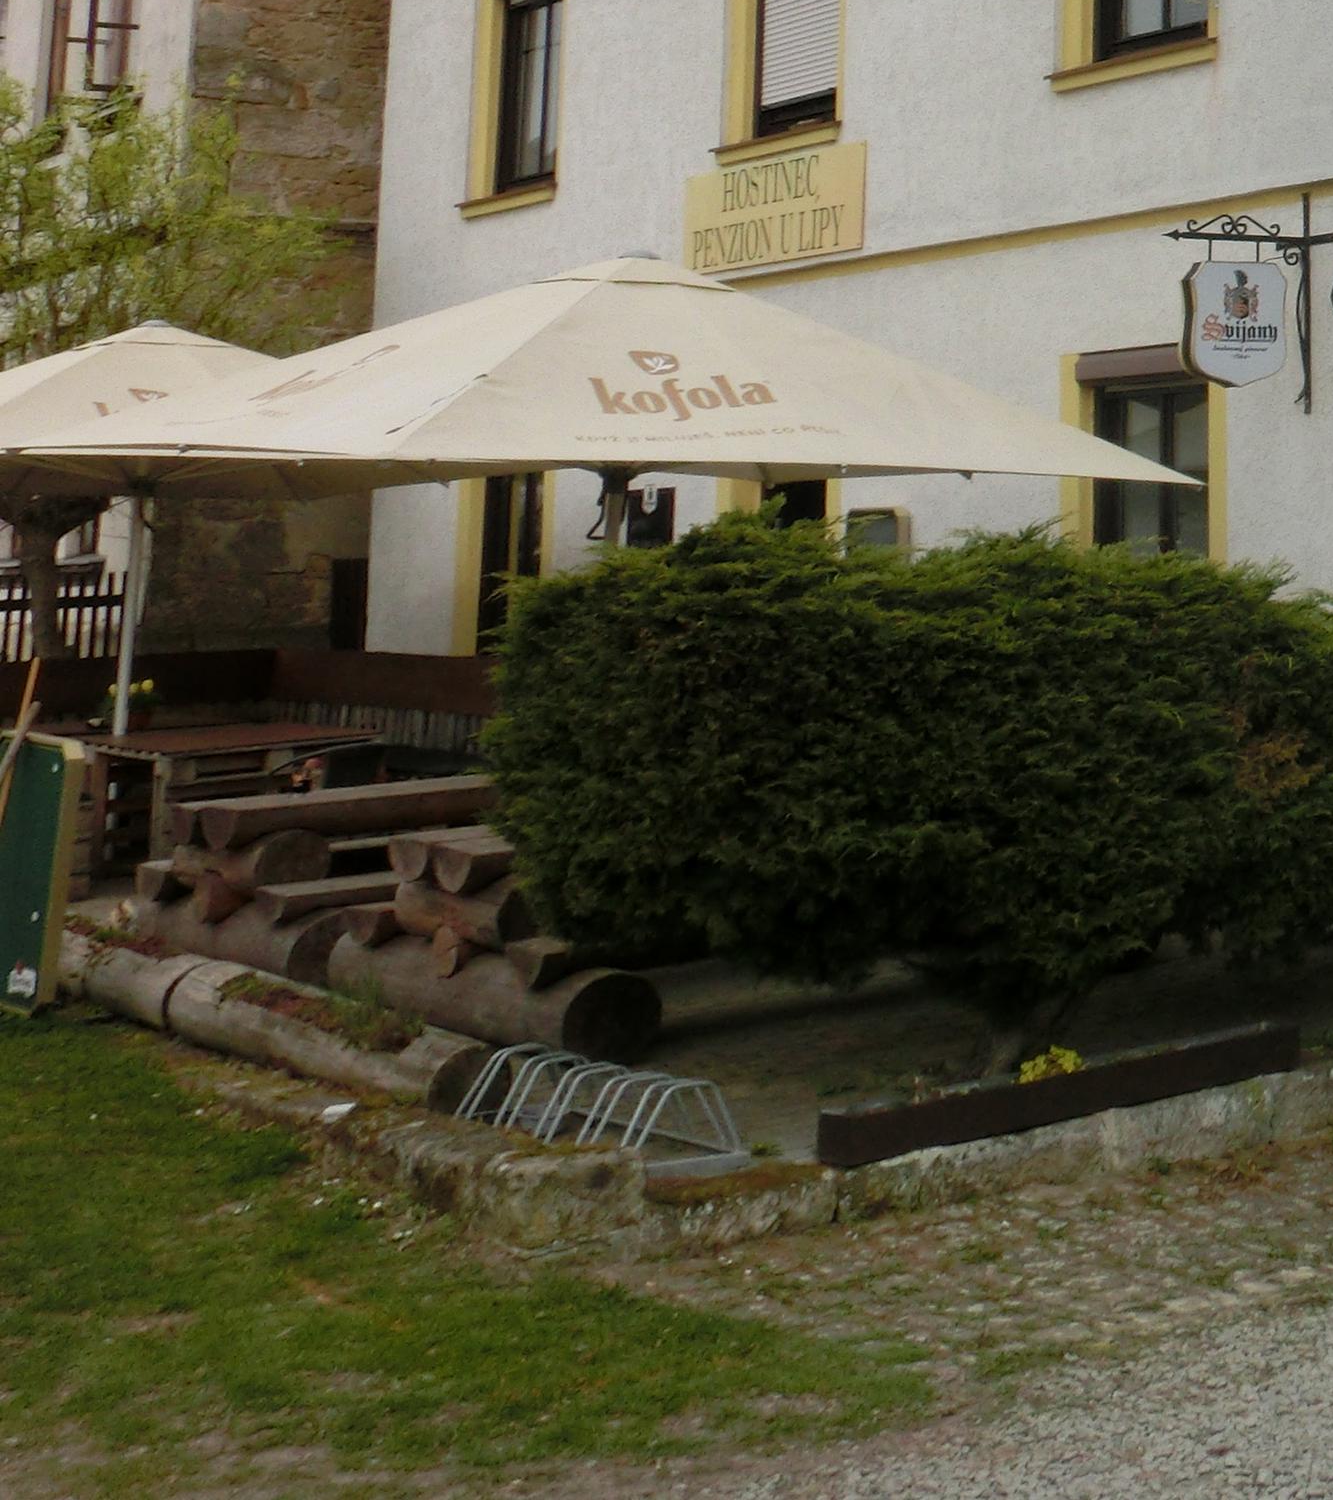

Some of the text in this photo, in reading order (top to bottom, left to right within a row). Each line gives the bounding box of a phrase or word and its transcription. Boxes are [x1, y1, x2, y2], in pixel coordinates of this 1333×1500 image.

[692, 204, 845, 270] PENZION U LIPY
[1201, 313, 1278, 343] Svijany
[588, 374, 778, 421] kofola
